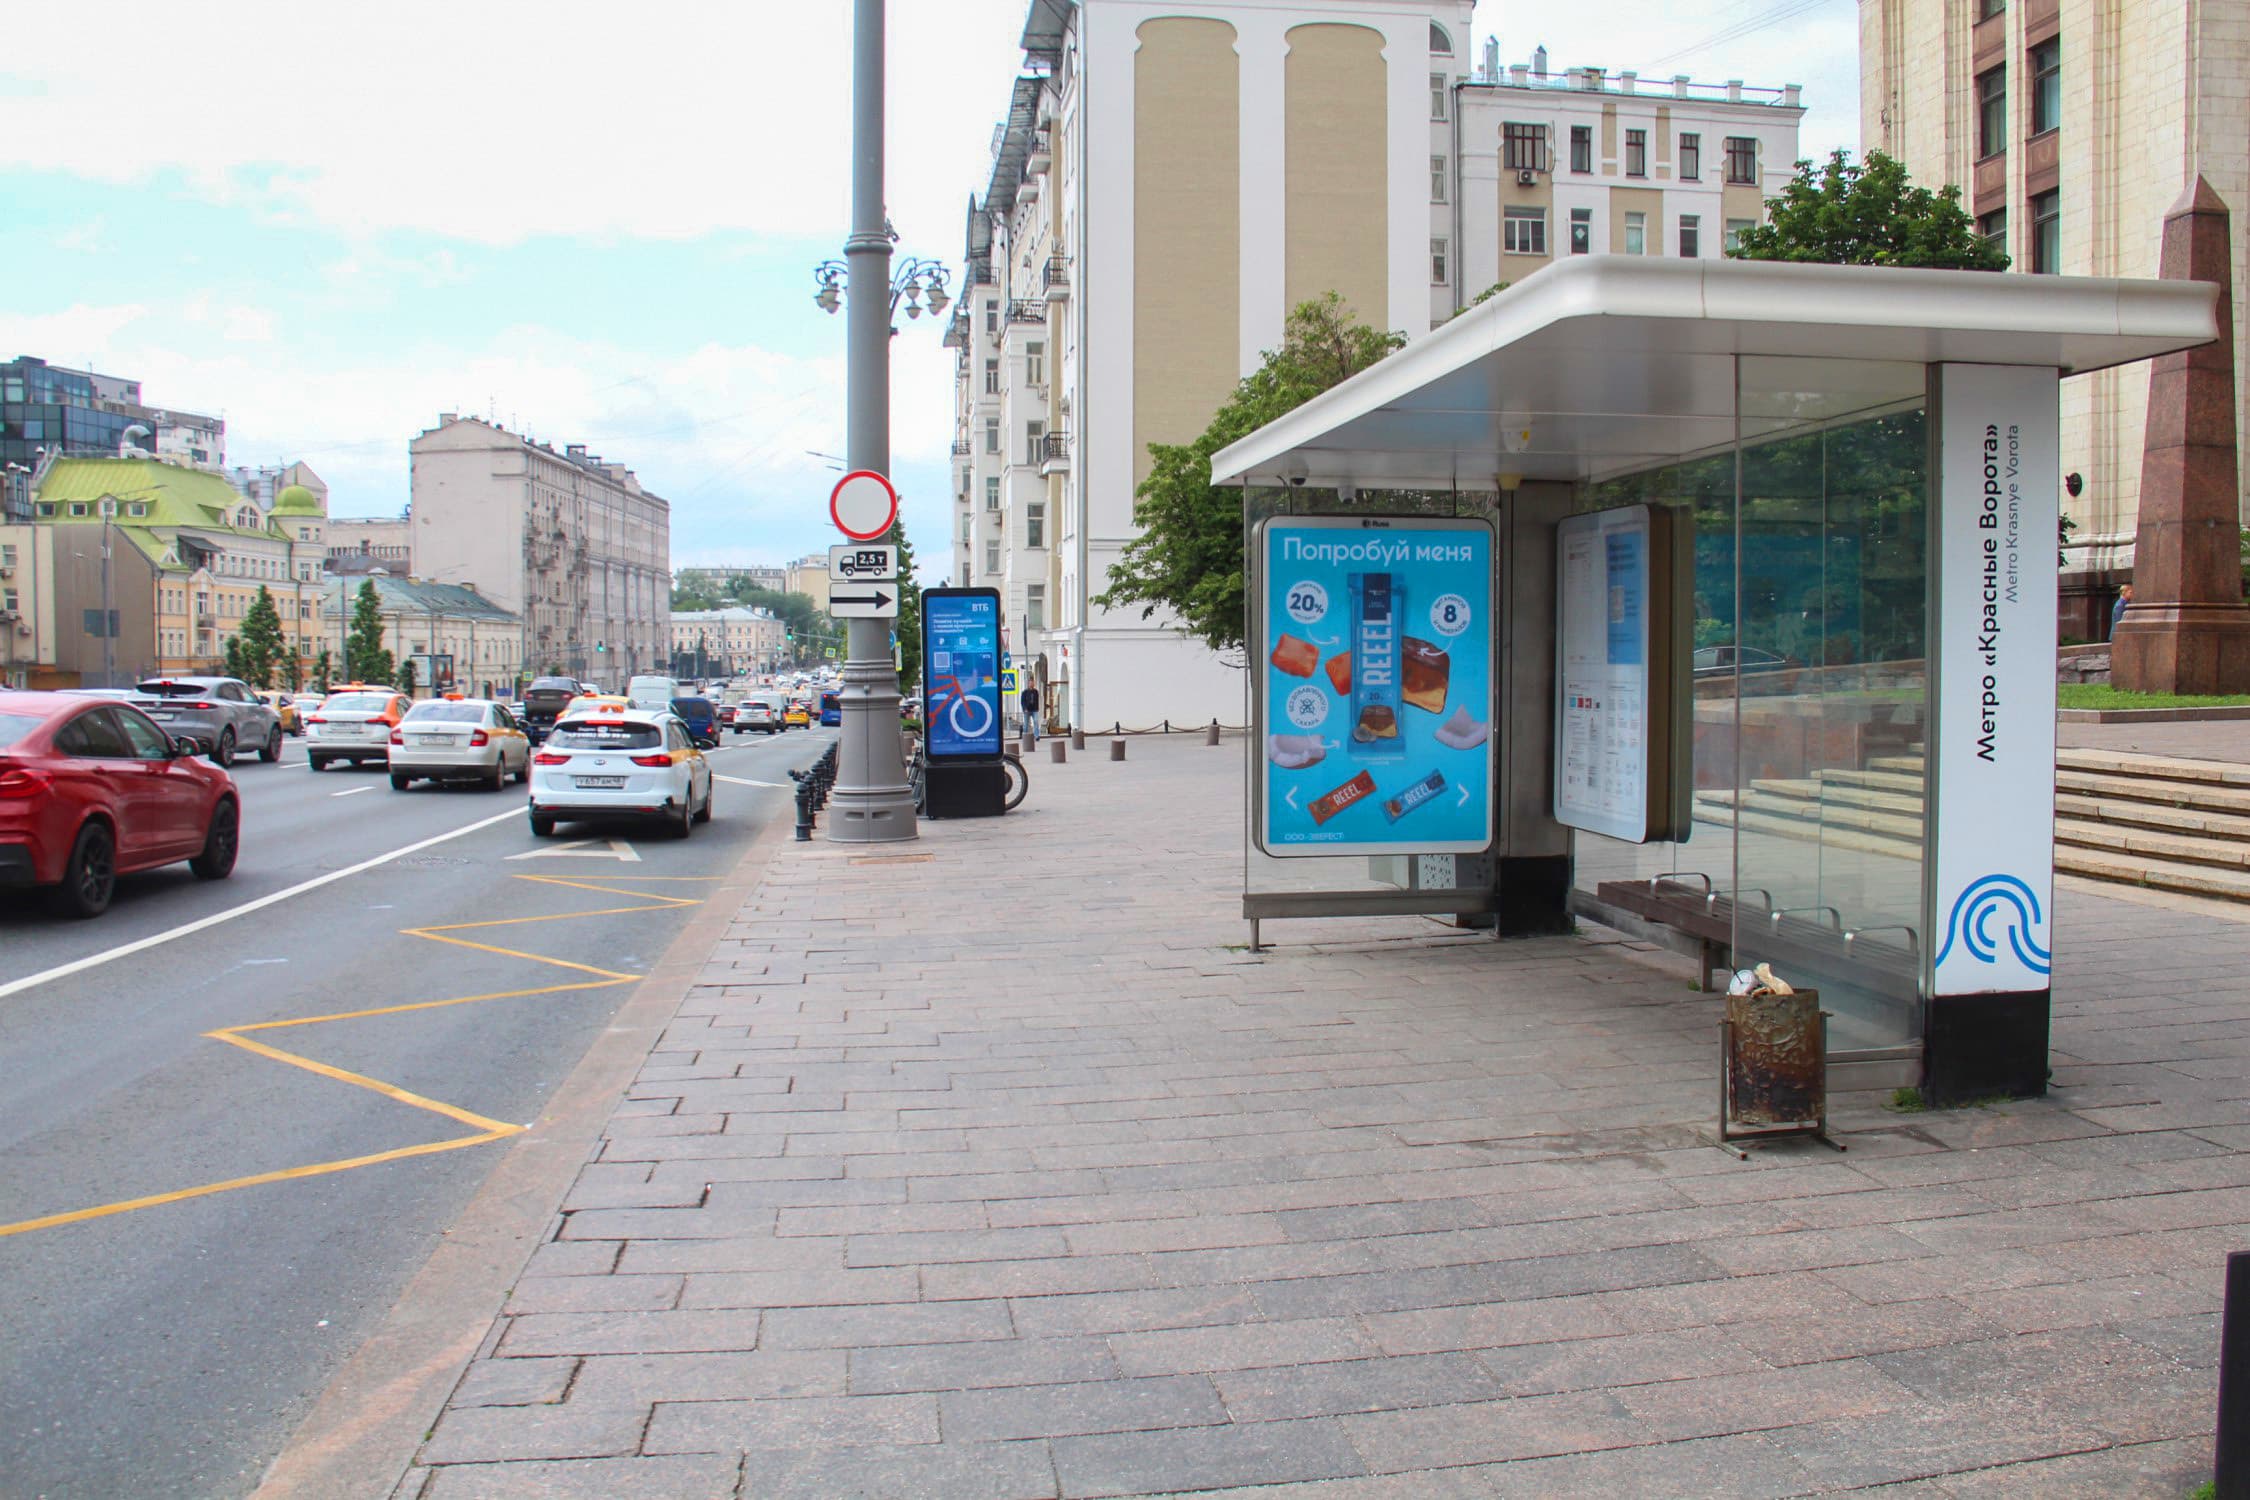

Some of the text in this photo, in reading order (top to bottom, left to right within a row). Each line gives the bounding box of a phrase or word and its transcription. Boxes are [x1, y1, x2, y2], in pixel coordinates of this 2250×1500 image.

[2006, 424, 2023, 603] Metro Krasnye Vorota
[858, 554, 876, 565] 2,5
[1283, 537, 1472, 567] Попробуй меня
[1290, 592, 1324, 613] 20%
[1977, 423, 2004, 762] Метро «Красные Ворота»
[971, 603, 989, 612] ВТБ
[1443, 604, 1457, 623] 8
[1362, 612, 1392, 686] REEEL
[1333, 783, 1362, 807] REEEL
[1405, 782, 1433, 804] REEEL
